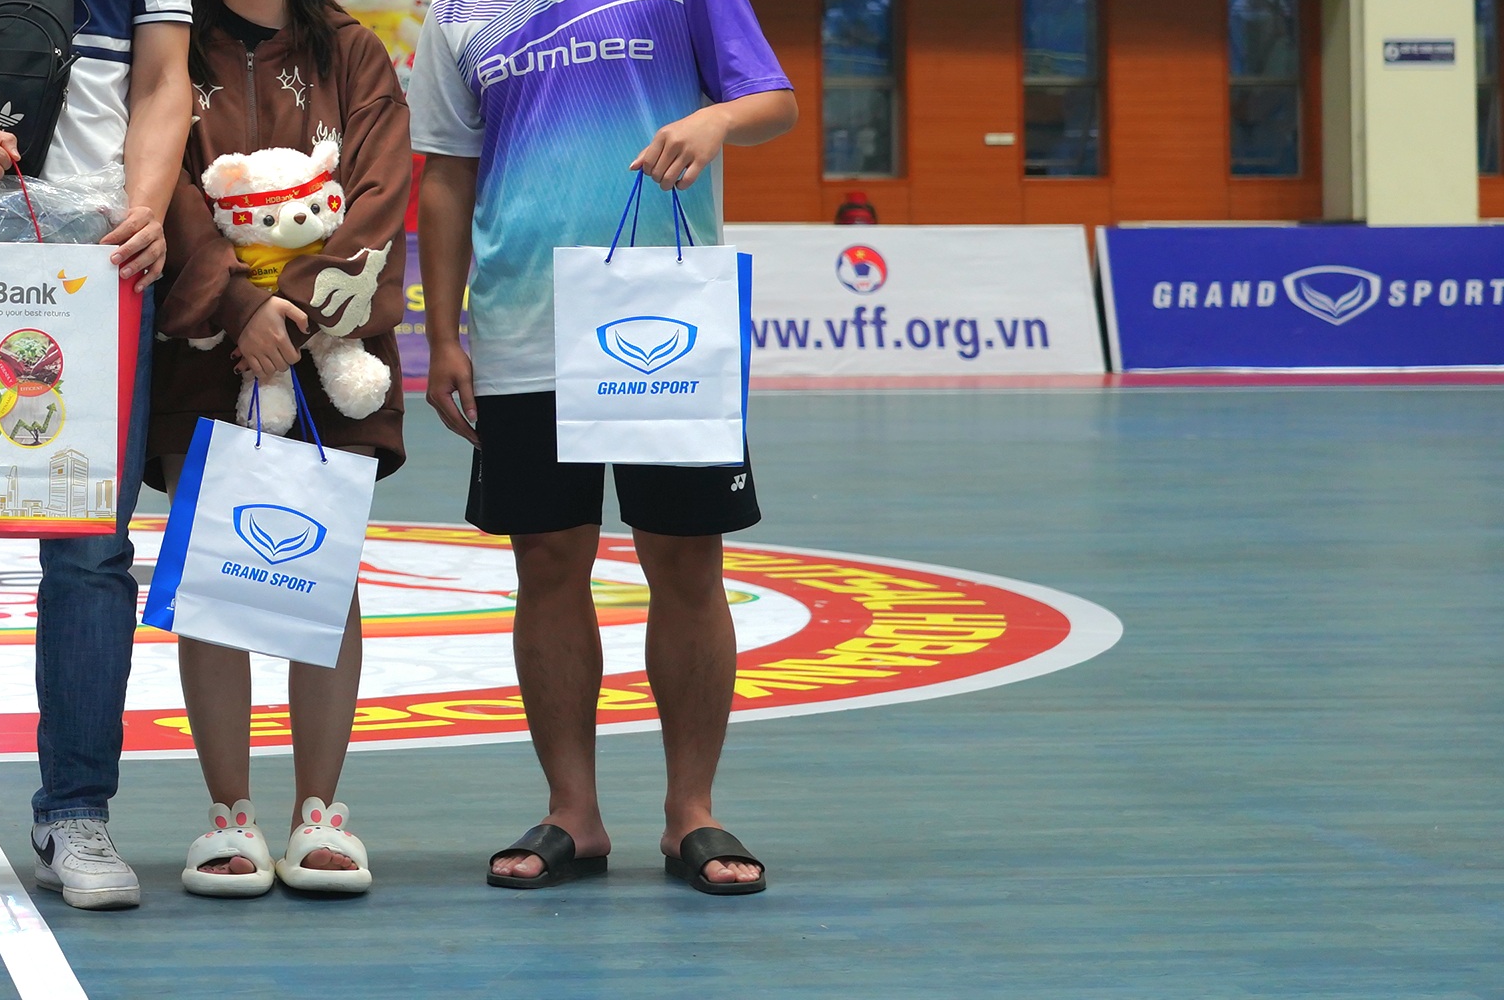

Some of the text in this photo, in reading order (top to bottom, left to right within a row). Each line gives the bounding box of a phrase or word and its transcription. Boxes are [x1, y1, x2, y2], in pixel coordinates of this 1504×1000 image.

[477, 36, 655, 95] Bumbee
[265, 193, 294, 204] HDBank
[1152, 278, 1504, 309] GRAND SPORT
[5, 310, 23, 318] your
[25, 308, 42, 317] best
[43, 309, 71, 317] returns
[597, 380, 700, 395] GRAND SPORT
[221, 560, 317, 595] GRAND SPORT
